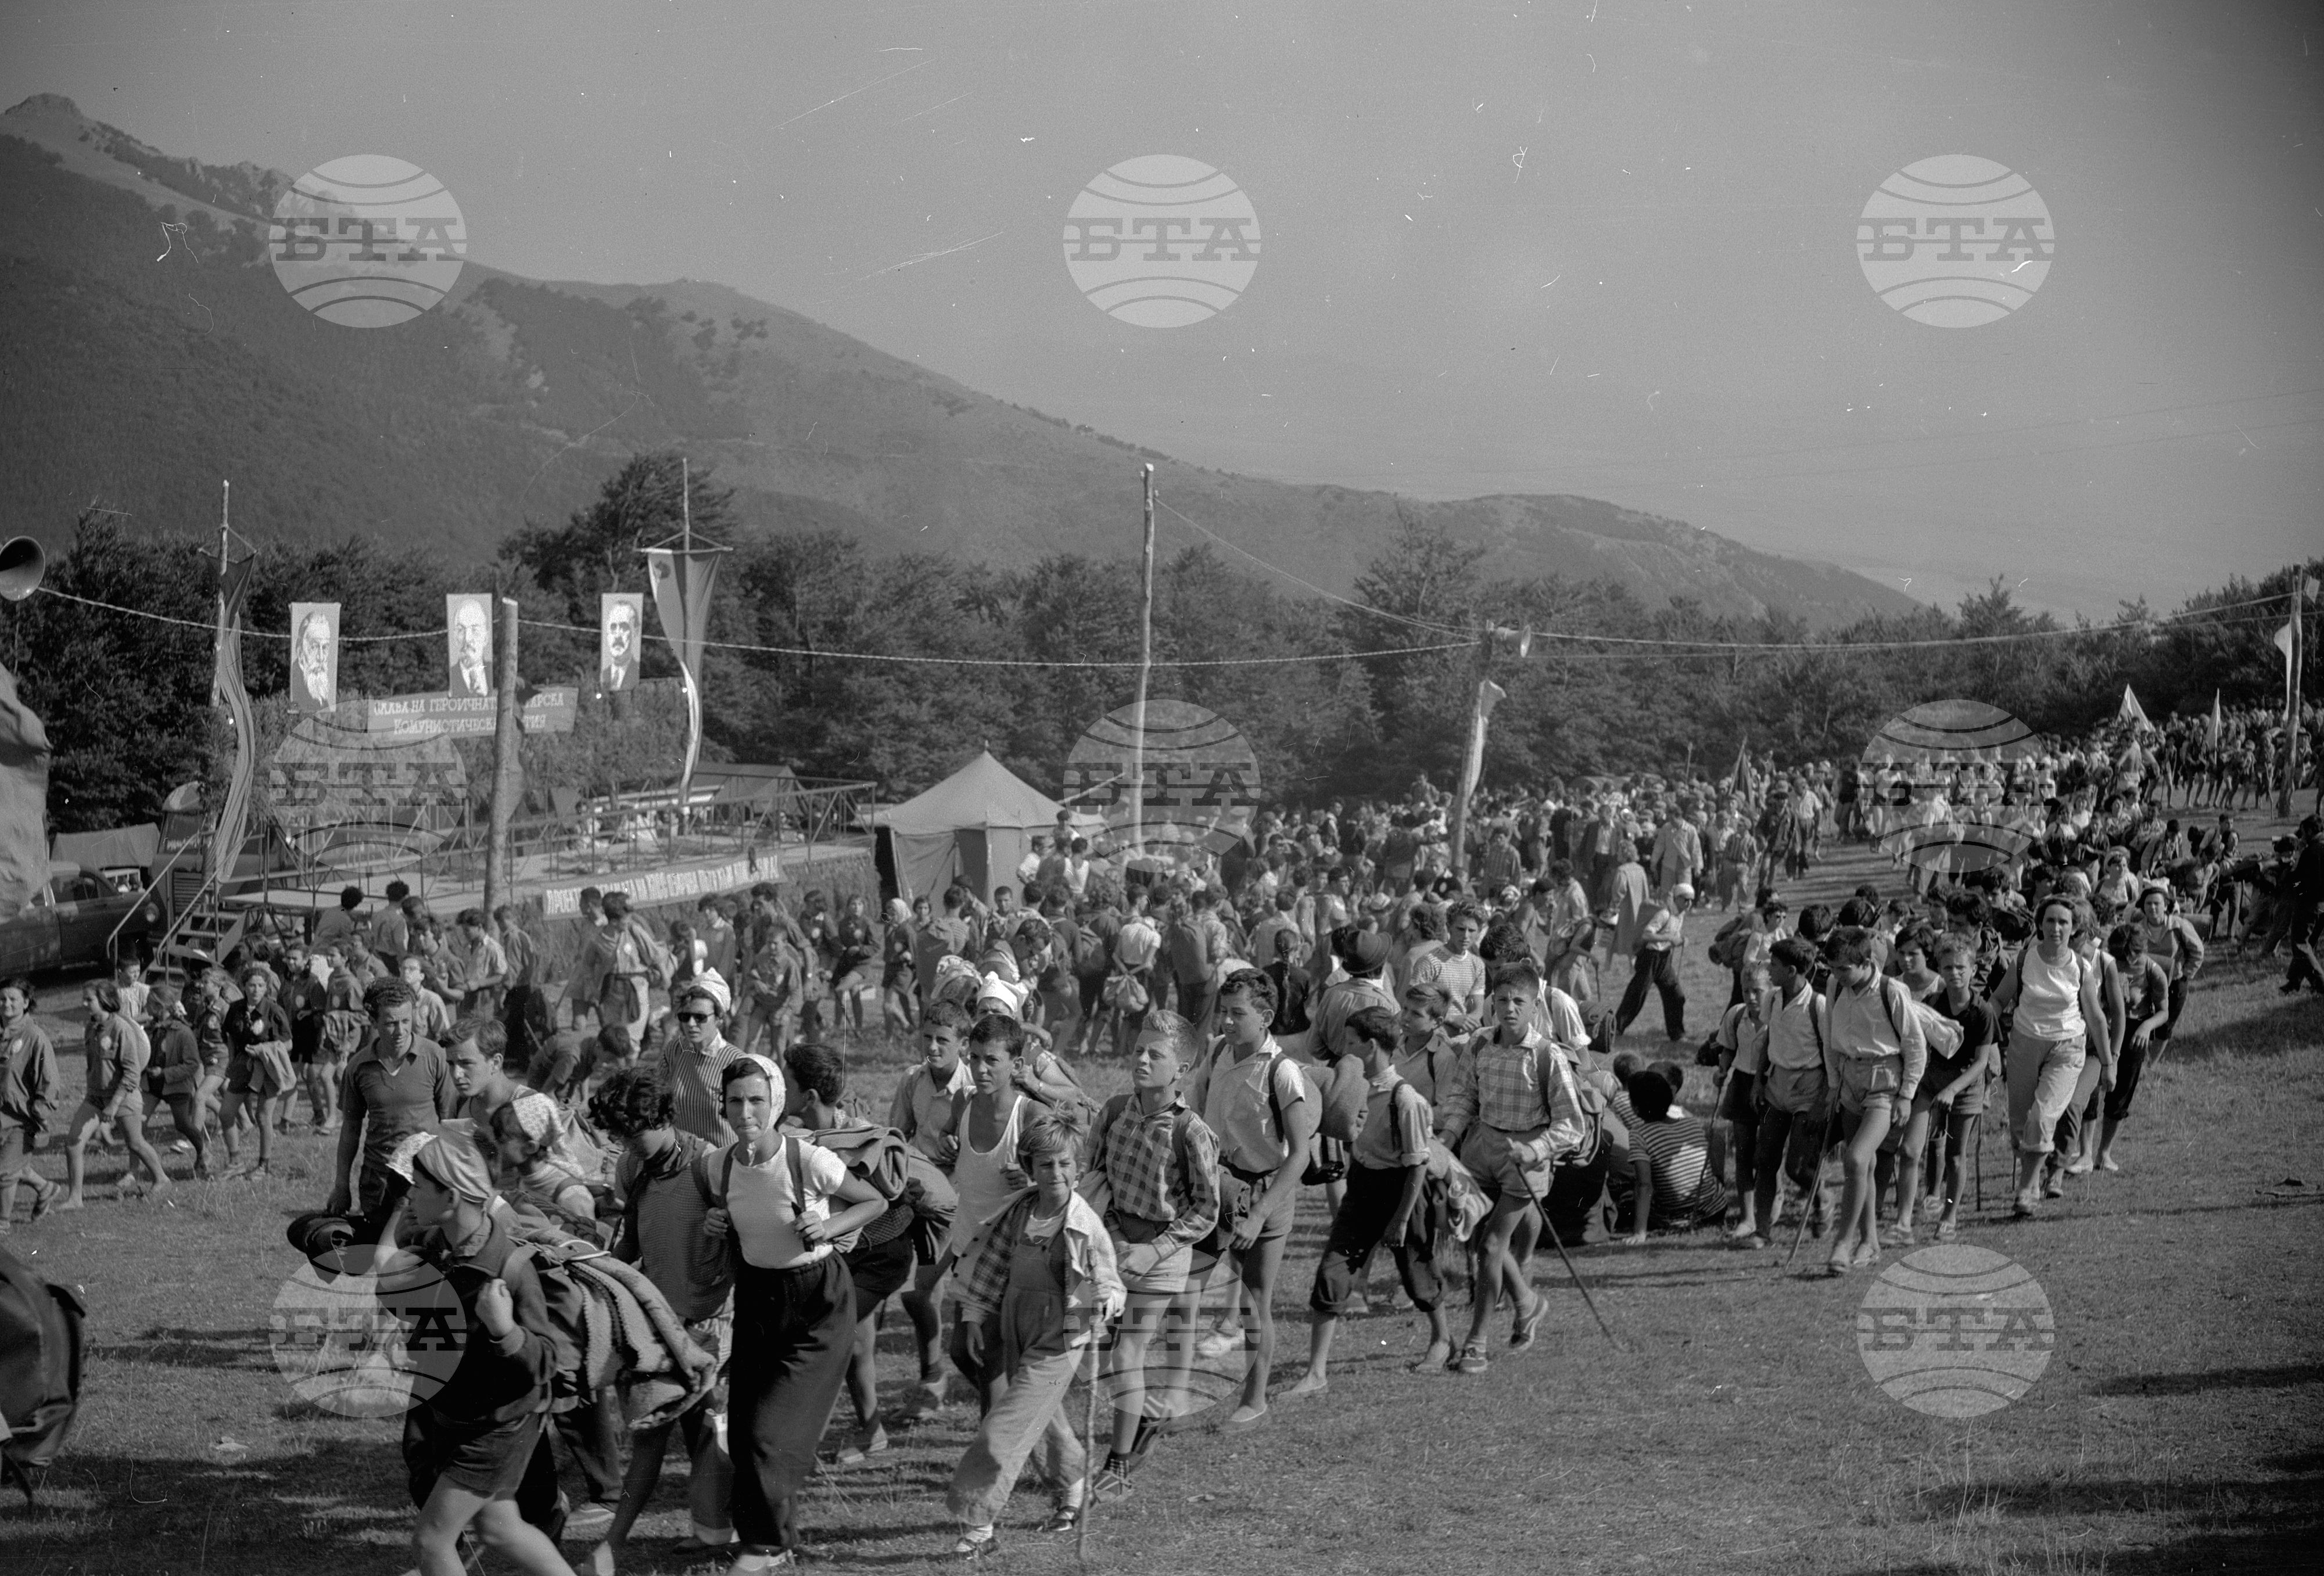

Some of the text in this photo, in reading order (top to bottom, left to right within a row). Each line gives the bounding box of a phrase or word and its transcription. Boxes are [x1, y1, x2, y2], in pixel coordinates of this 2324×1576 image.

[374, 701, 408, 715] СЛАВА
[411, 699, 425, 713] НА
[429, 697, 497, 712] ГЕРОИЧНАТ
[524, 714, 546, 728] ТИЯ
